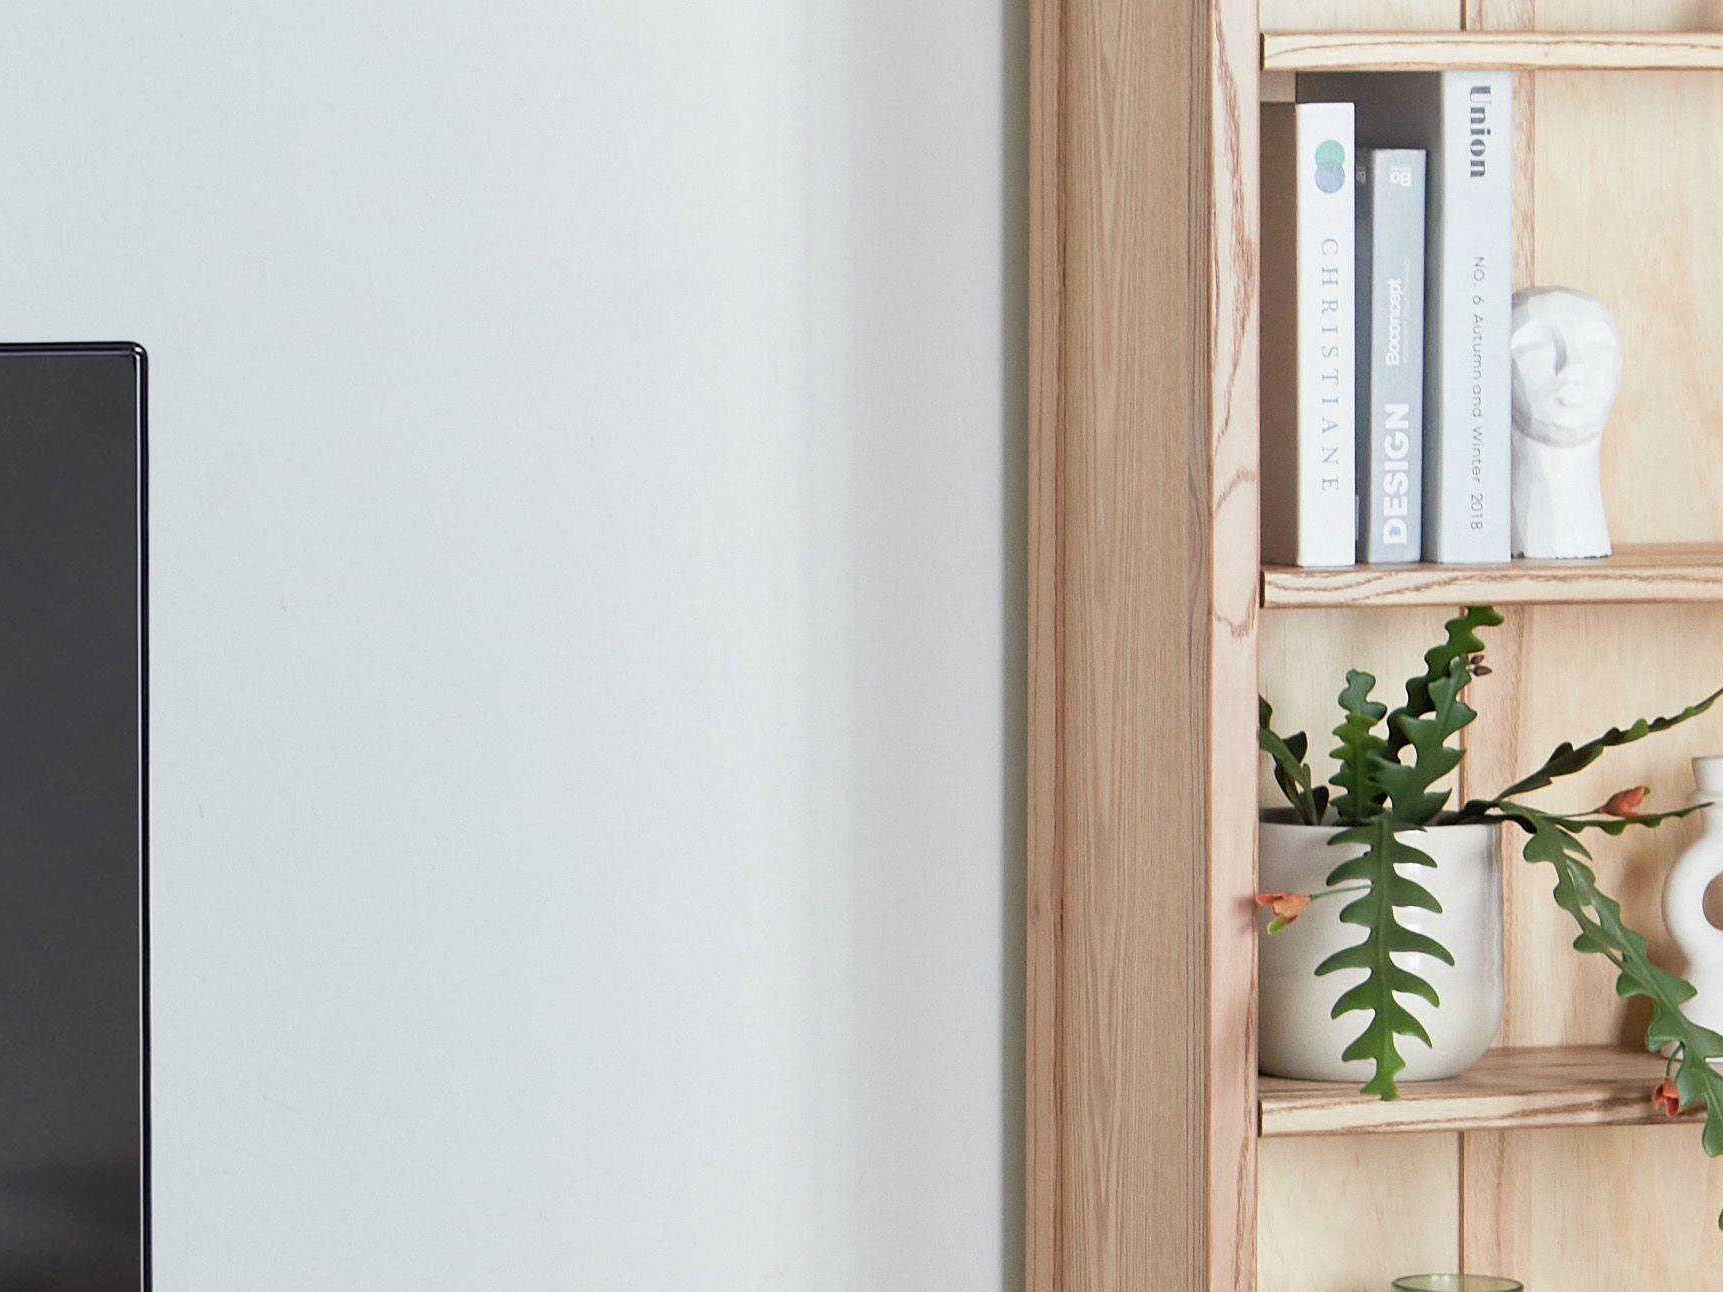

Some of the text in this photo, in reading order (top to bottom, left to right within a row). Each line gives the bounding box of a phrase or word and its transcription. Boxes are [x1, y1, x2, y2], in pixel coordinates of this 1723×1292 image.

[1469, 85, 1492, 178] Union
[1472, 295, 1485, 305] 6
[1320, 238, 1340, 492] CHRISTIANE
[1471, 313, 1484, 381] Autumn
[1471, 384, 1484, 418] and
[1382, 403, 1410, 545] DESIGN
[1470, 425, 1484, 484] Winter
[1470, 492, 1484, 531] 2018
